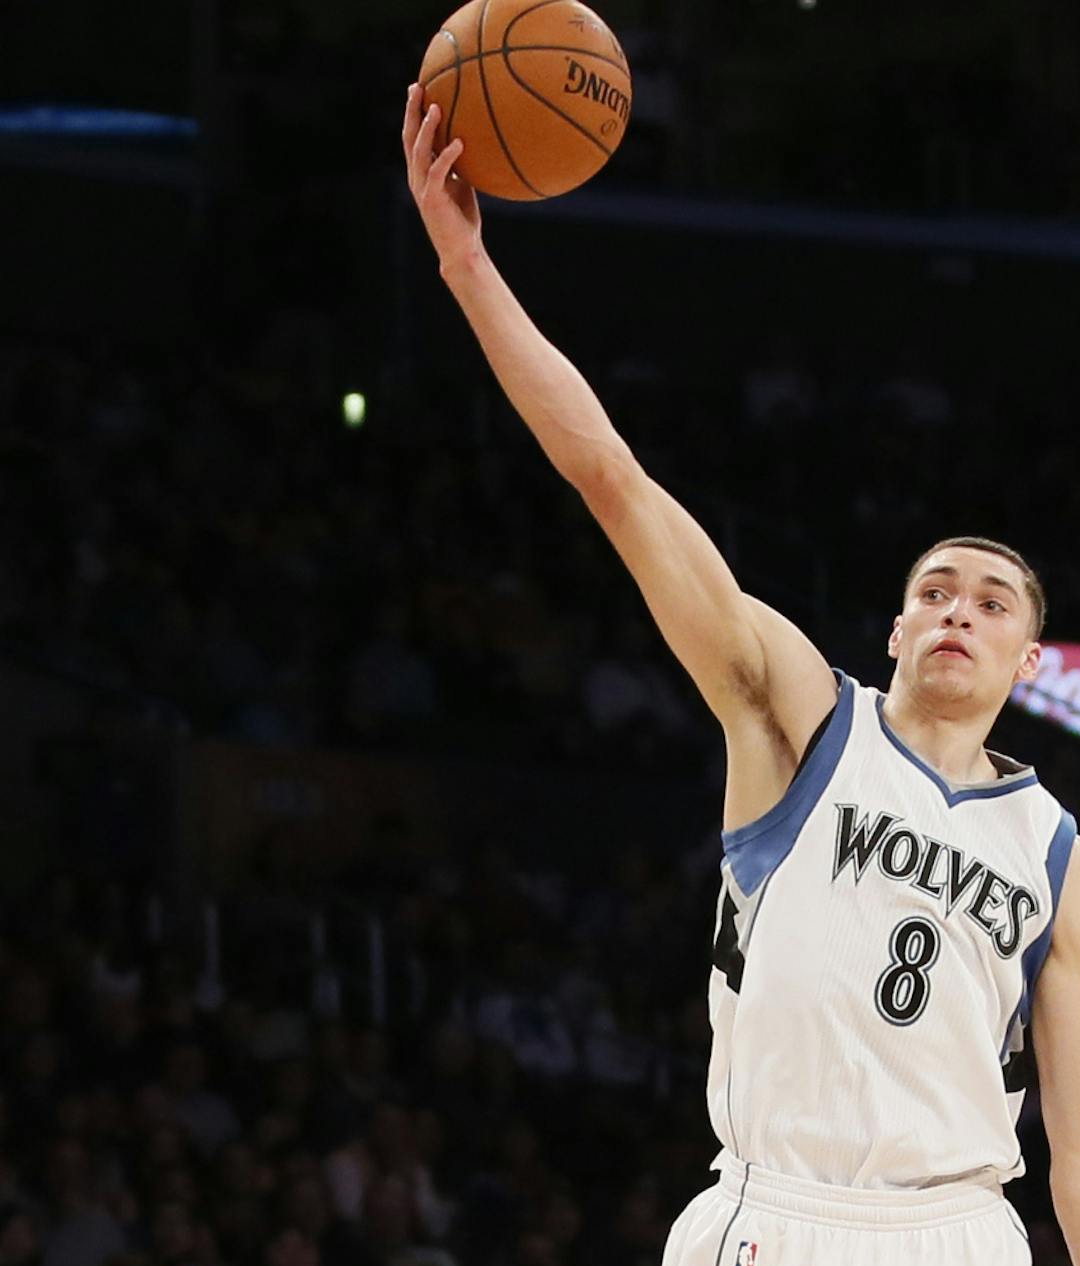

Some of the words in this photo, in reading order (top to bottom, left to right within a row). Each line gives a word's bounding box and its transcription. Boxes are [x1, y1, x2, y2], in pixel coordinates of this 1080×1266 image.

[564, 58, 630, 124] LDING
[832, 803, 1041, 960] WOLVES
[875, 916, 941, 1027] 8
